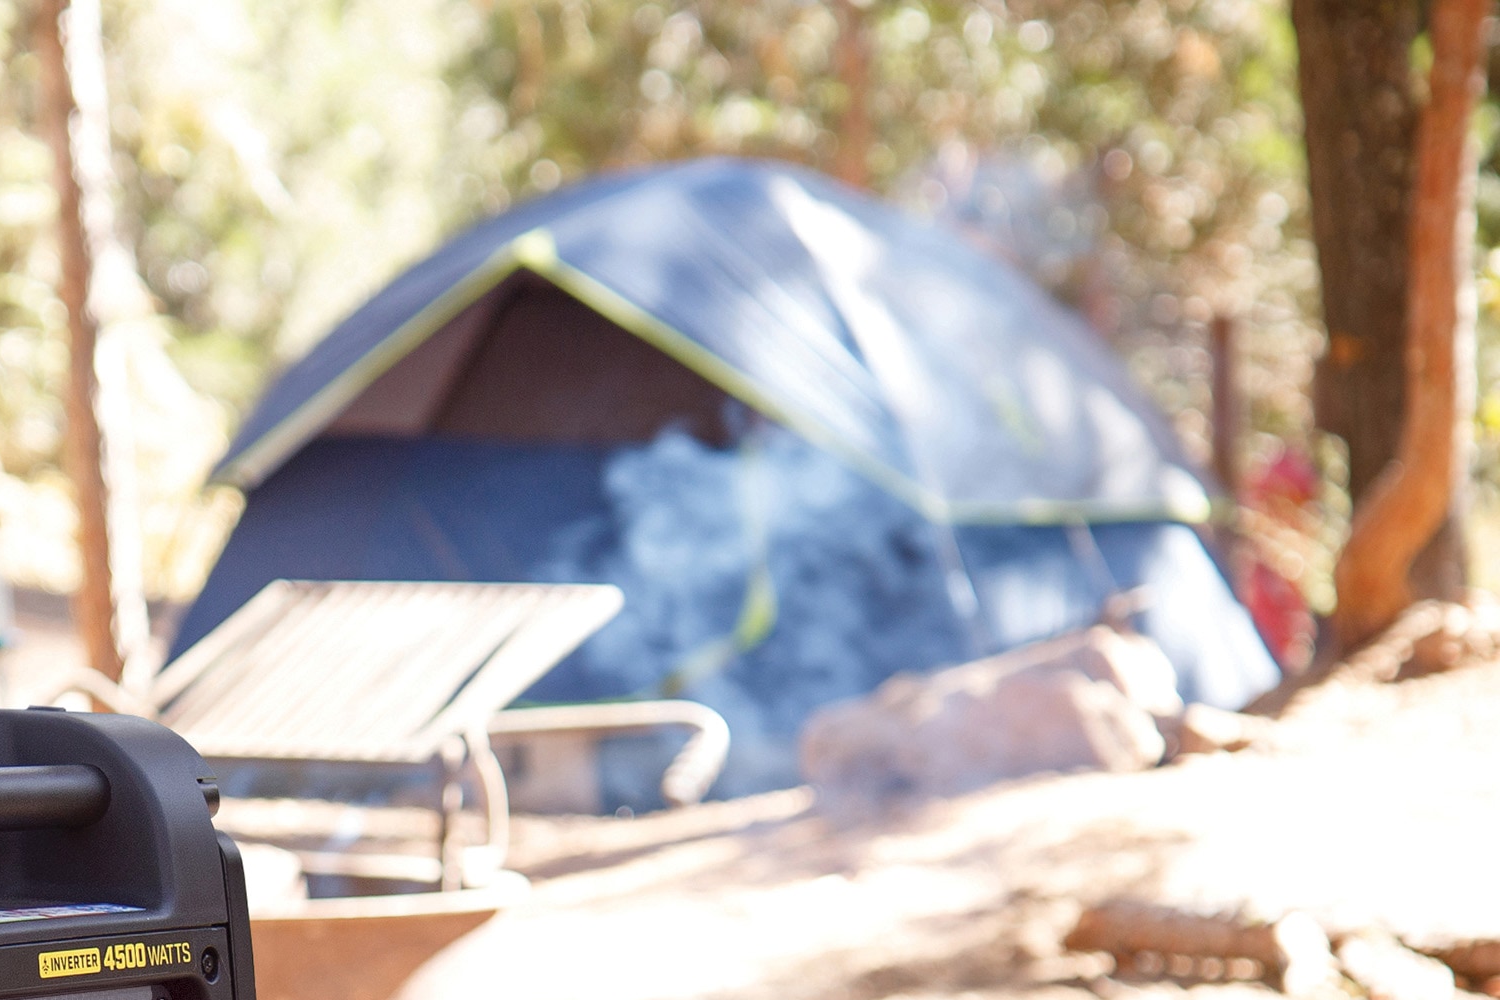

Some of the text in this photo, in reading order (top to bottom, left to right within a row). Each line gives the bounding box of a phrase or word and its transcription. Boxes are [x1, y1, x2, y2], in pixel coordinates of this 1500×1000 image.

[50, 941, 192, 972] INVERTER 4500 WATTS
